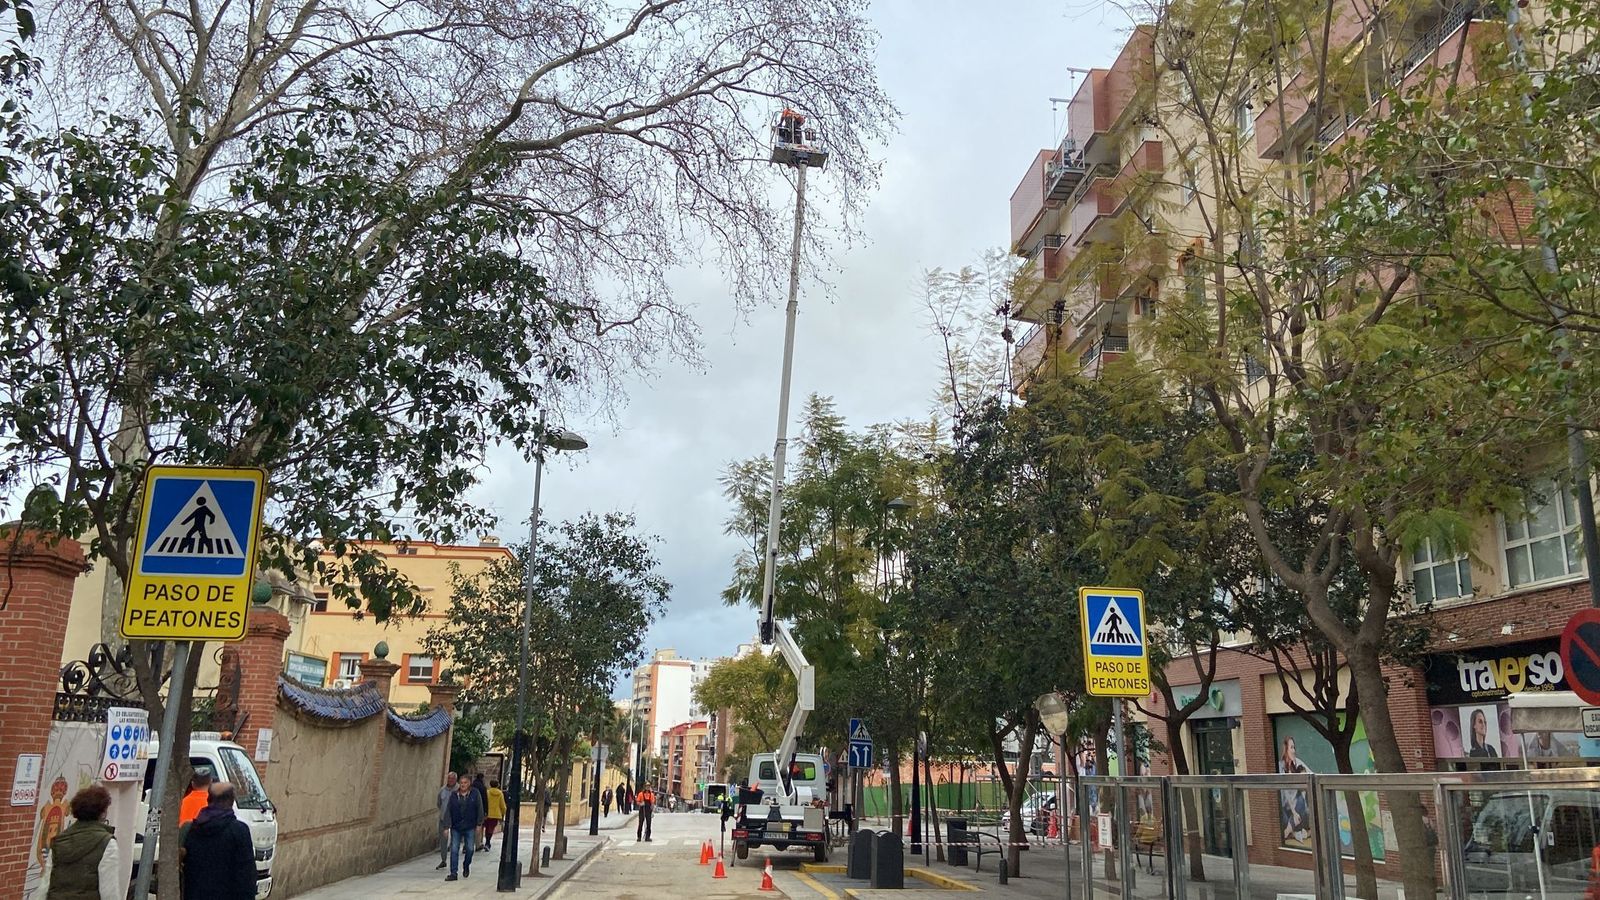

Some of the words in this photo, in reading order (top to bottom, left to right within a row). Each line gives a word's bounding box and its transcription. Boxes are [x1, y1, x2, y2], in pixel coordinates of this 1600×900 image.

[143, 583, 200, 602] PASO
[206, 585, 236, 602] DE
[129, 609, 241, 629] PEATONES
[1095, 661, 1124, 673] PASO
[1127, 662, 1142, 674] DE
[1457, 651, 1564, 693] traverso
[1091, 677, 1148, 690] PEATONES
